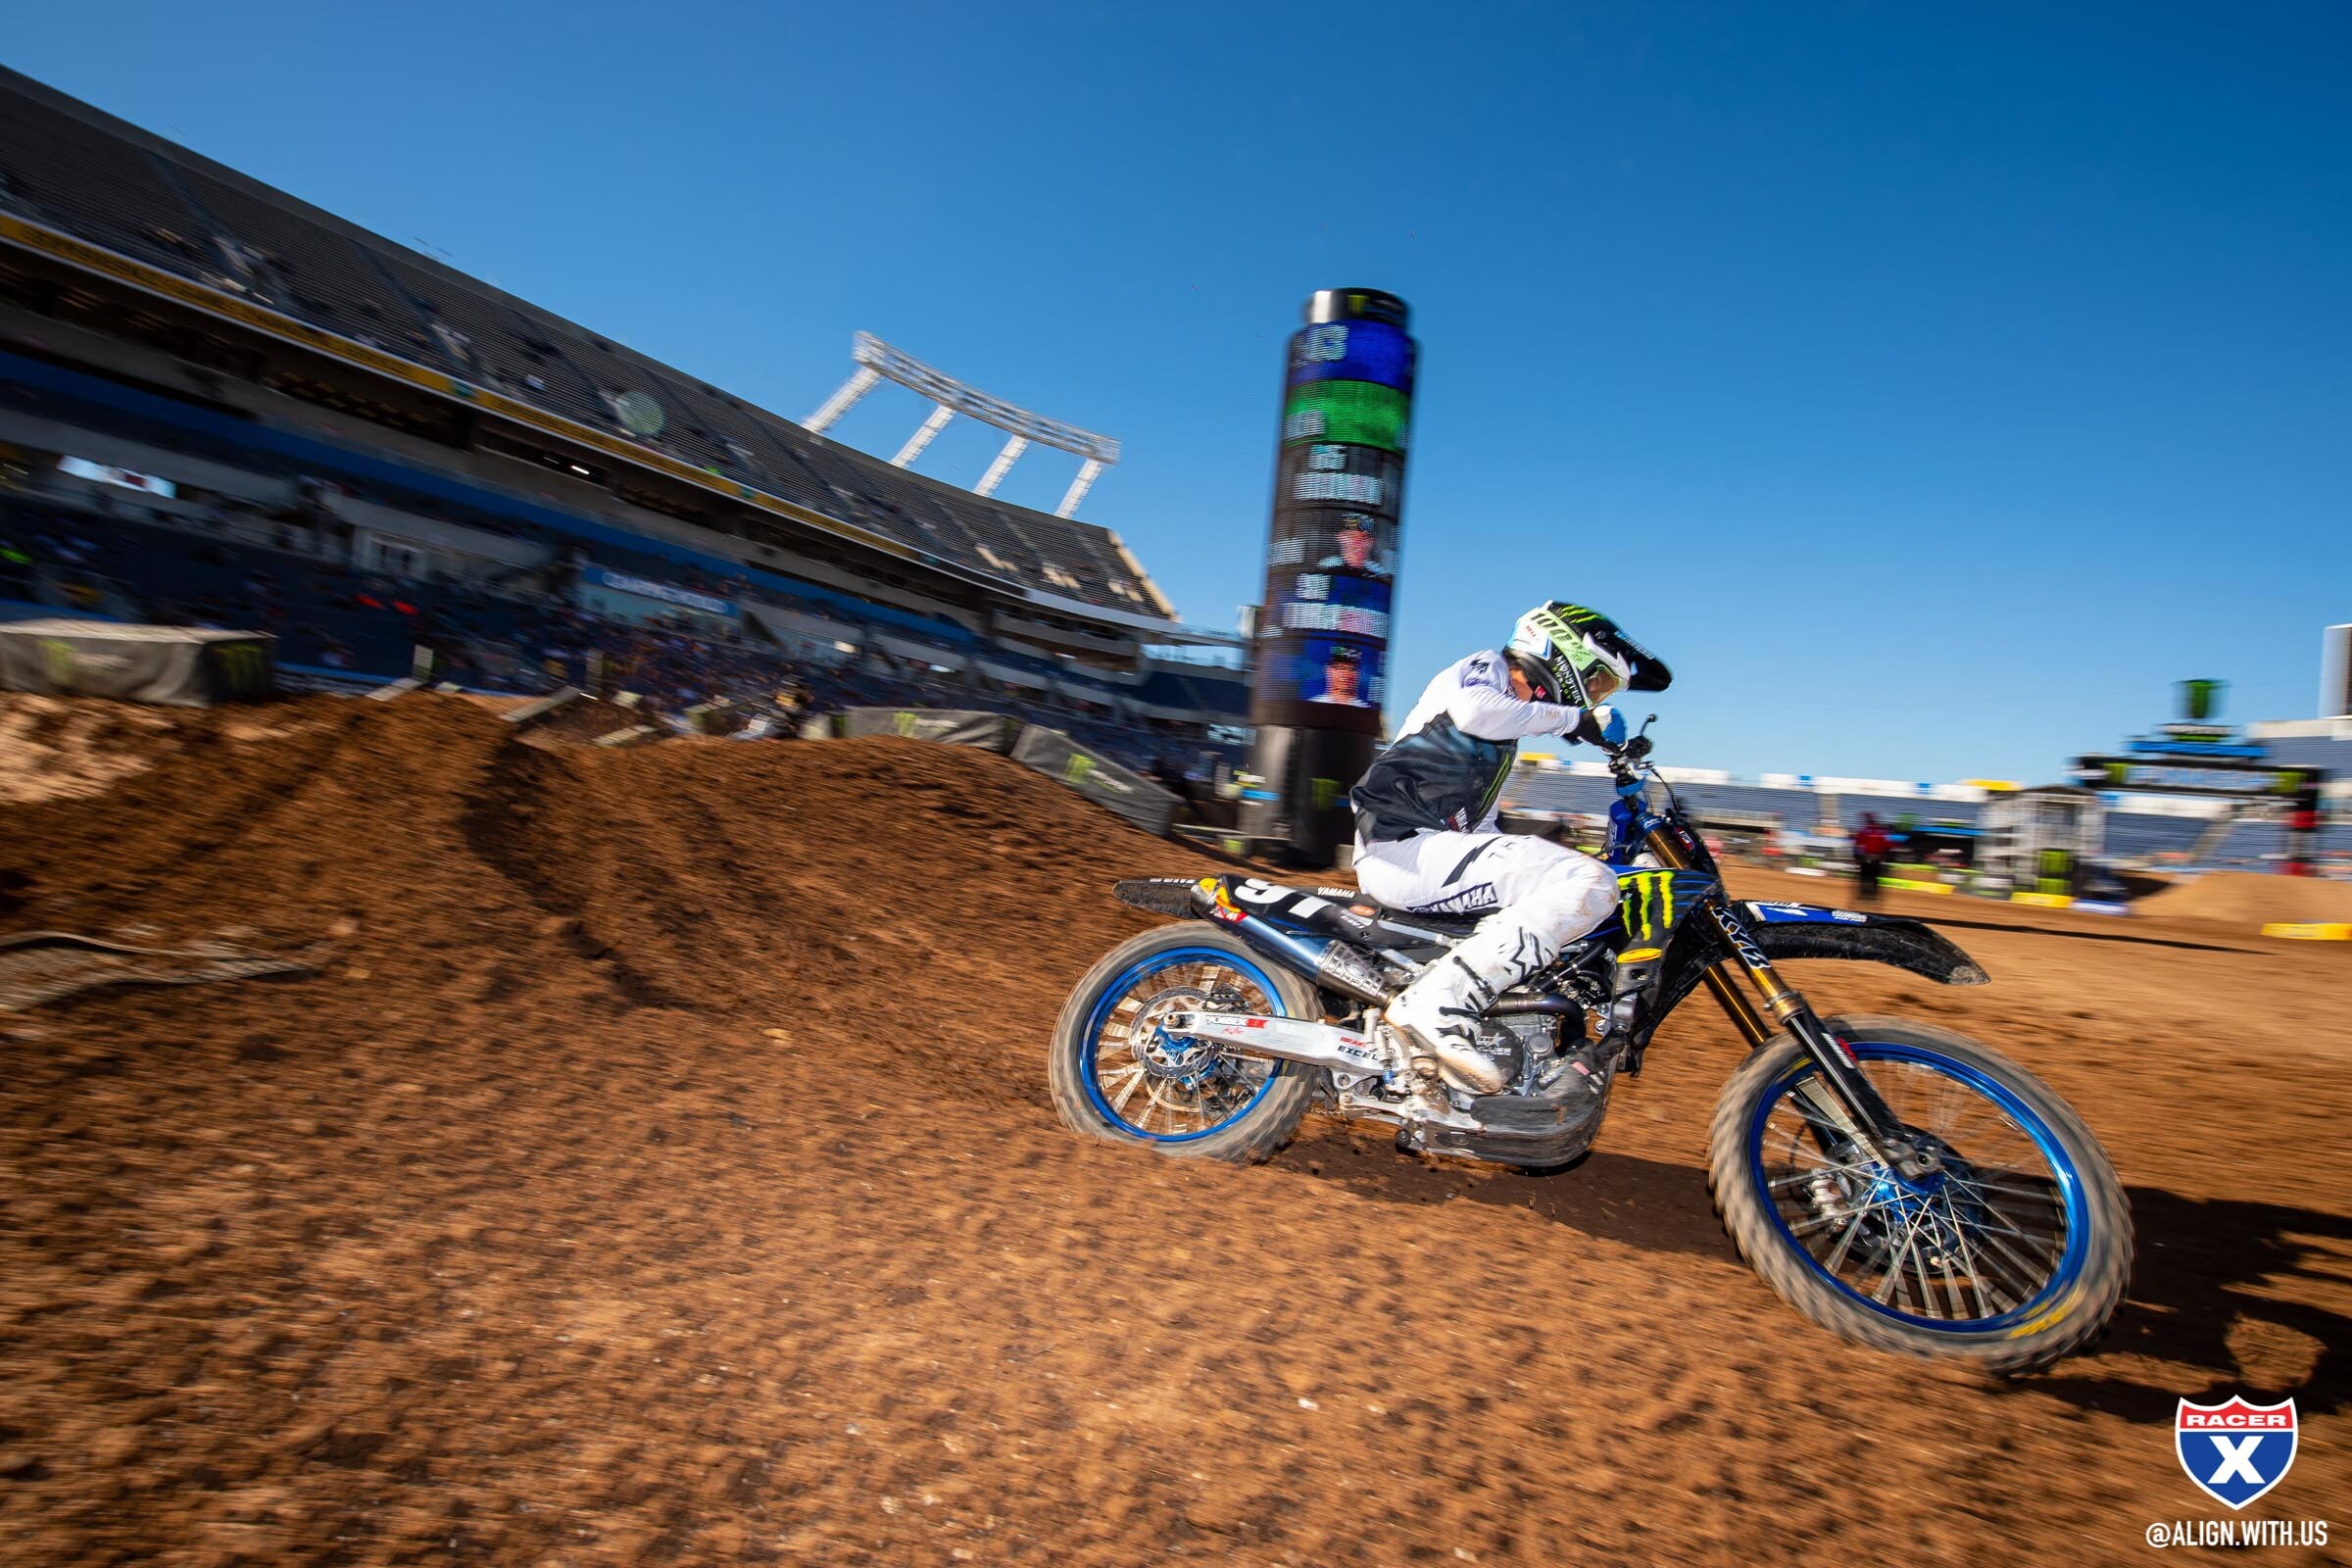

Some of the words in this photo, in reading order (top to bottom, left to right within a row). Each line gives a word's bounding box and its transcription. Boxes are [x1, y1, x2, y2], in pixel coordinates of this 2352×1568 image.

[1554, 655, 1583, 705] MONSTER
[1317, 886, 1356, 899] YAMAHA
[1429, 885, 1497, 915] YAMAHA
[1710, 906, 1772, 969] KYB
[1337, 1045, 1380, 1061] EXCEL
